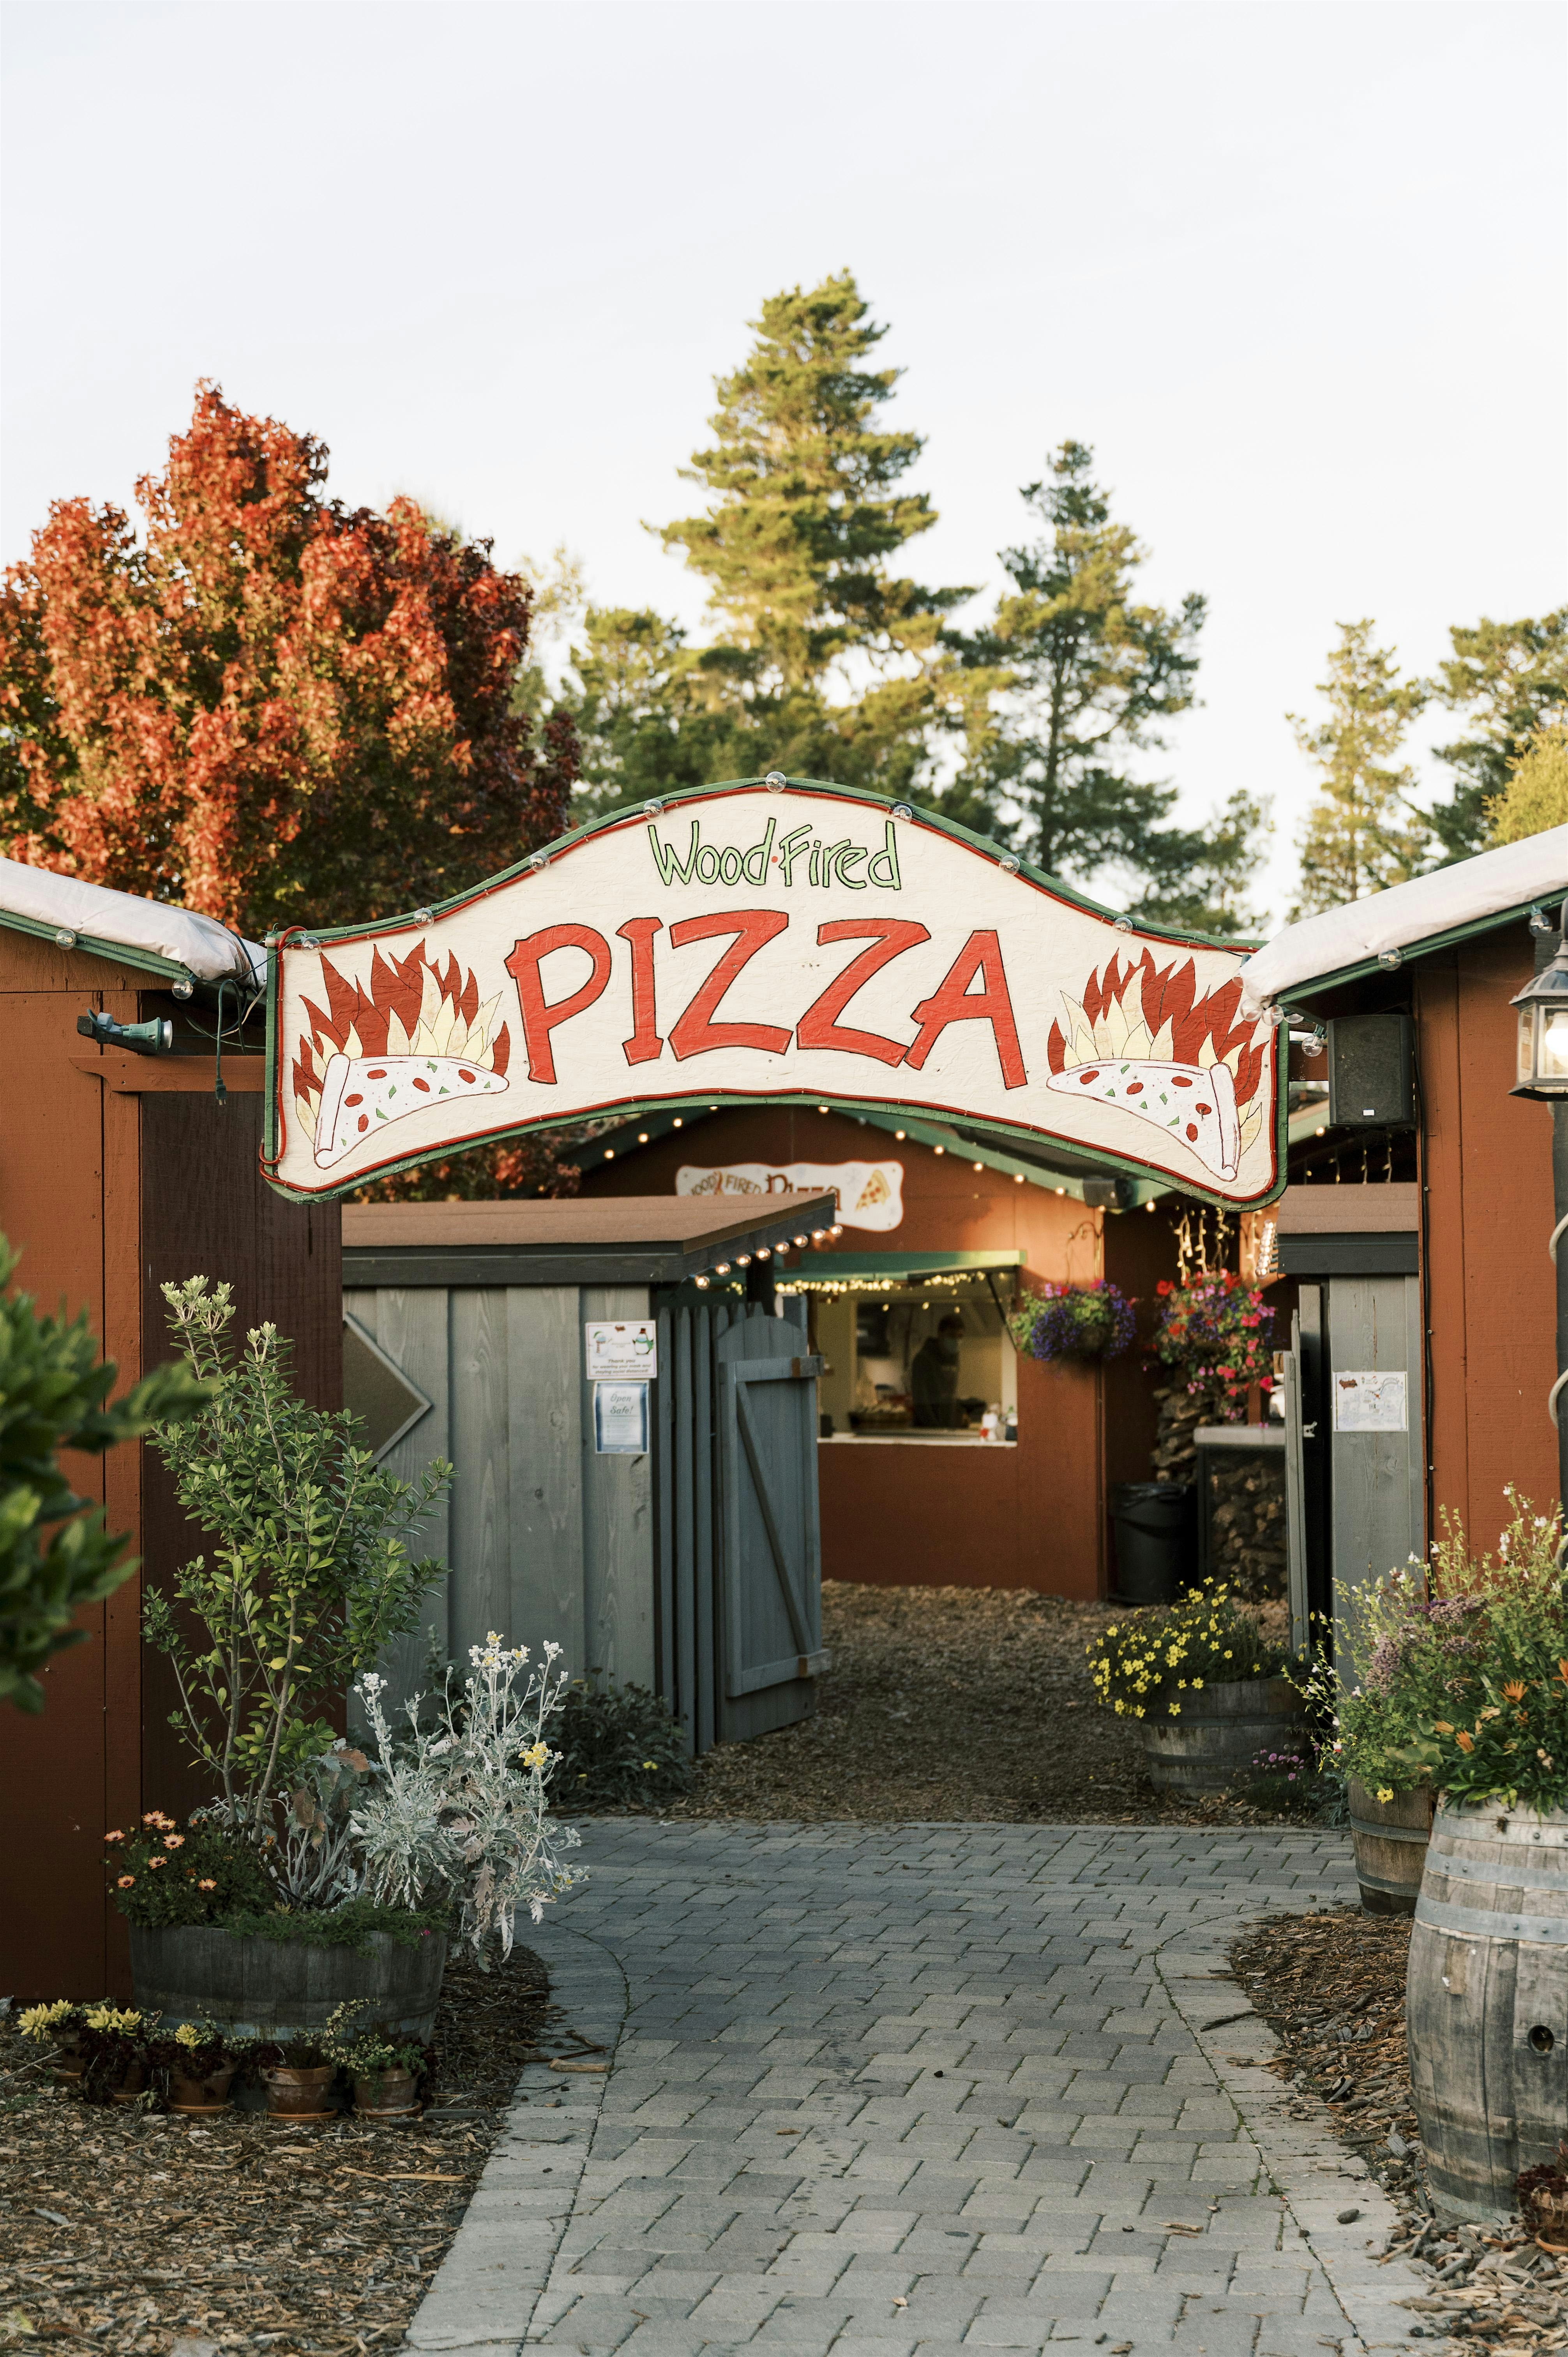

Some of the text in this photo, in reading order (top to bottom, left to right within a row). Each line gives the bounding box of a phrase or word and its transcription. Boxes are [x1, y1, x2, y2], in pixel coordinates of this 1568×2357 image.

[505, 909, 1028, 1090] PIZZA
[611, 1393, 632, 1403] Open
[610, 1406, 634, 1414] Safe!
